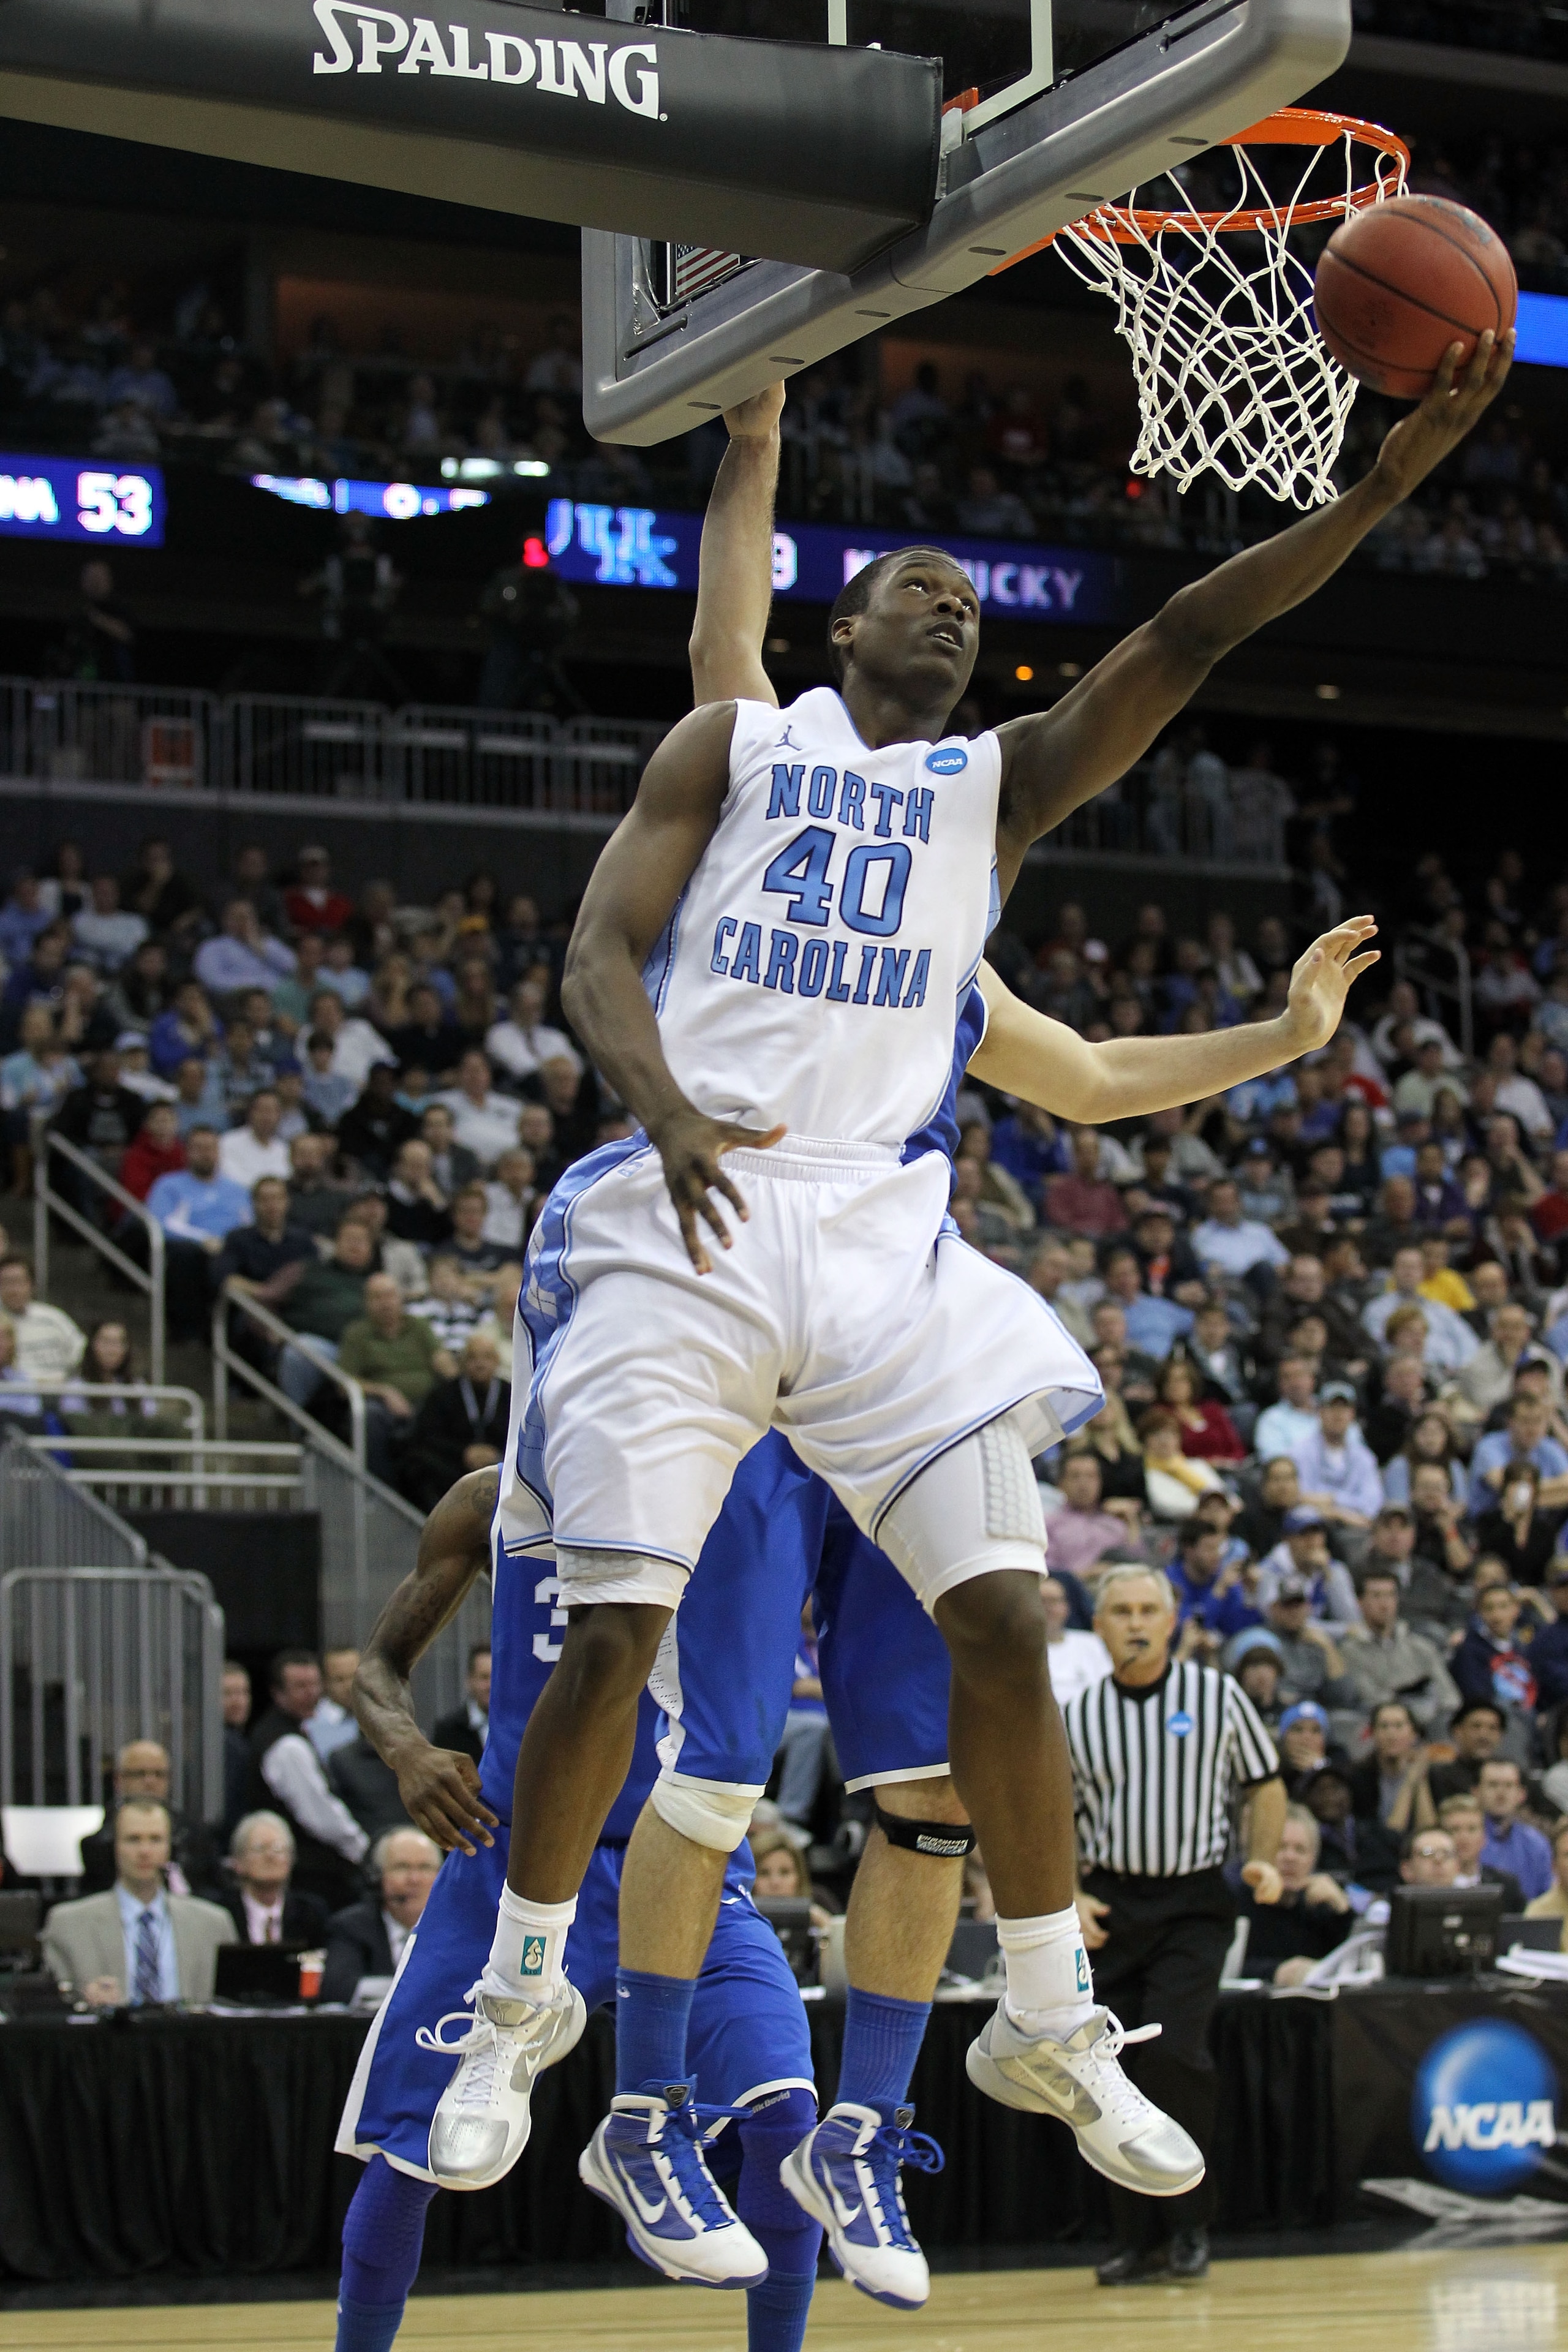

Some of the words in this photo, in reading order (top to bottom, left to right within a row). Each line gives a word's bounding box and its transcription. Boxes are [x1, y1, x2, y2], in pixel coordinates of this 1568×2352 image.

[313, 0, 659, 120] SPALDING
[77, 471, 153, 535] 53
[766, 763, 935, 845] NORTH
[932, 758, 963, 769] NCAA
[761, 824, 913, 938] 40
[710, 916, 932, 1008] CAROLINA
[532, 1577, 570, 1663] 3
[1423, 2098, 1557, 2152] NCAA
